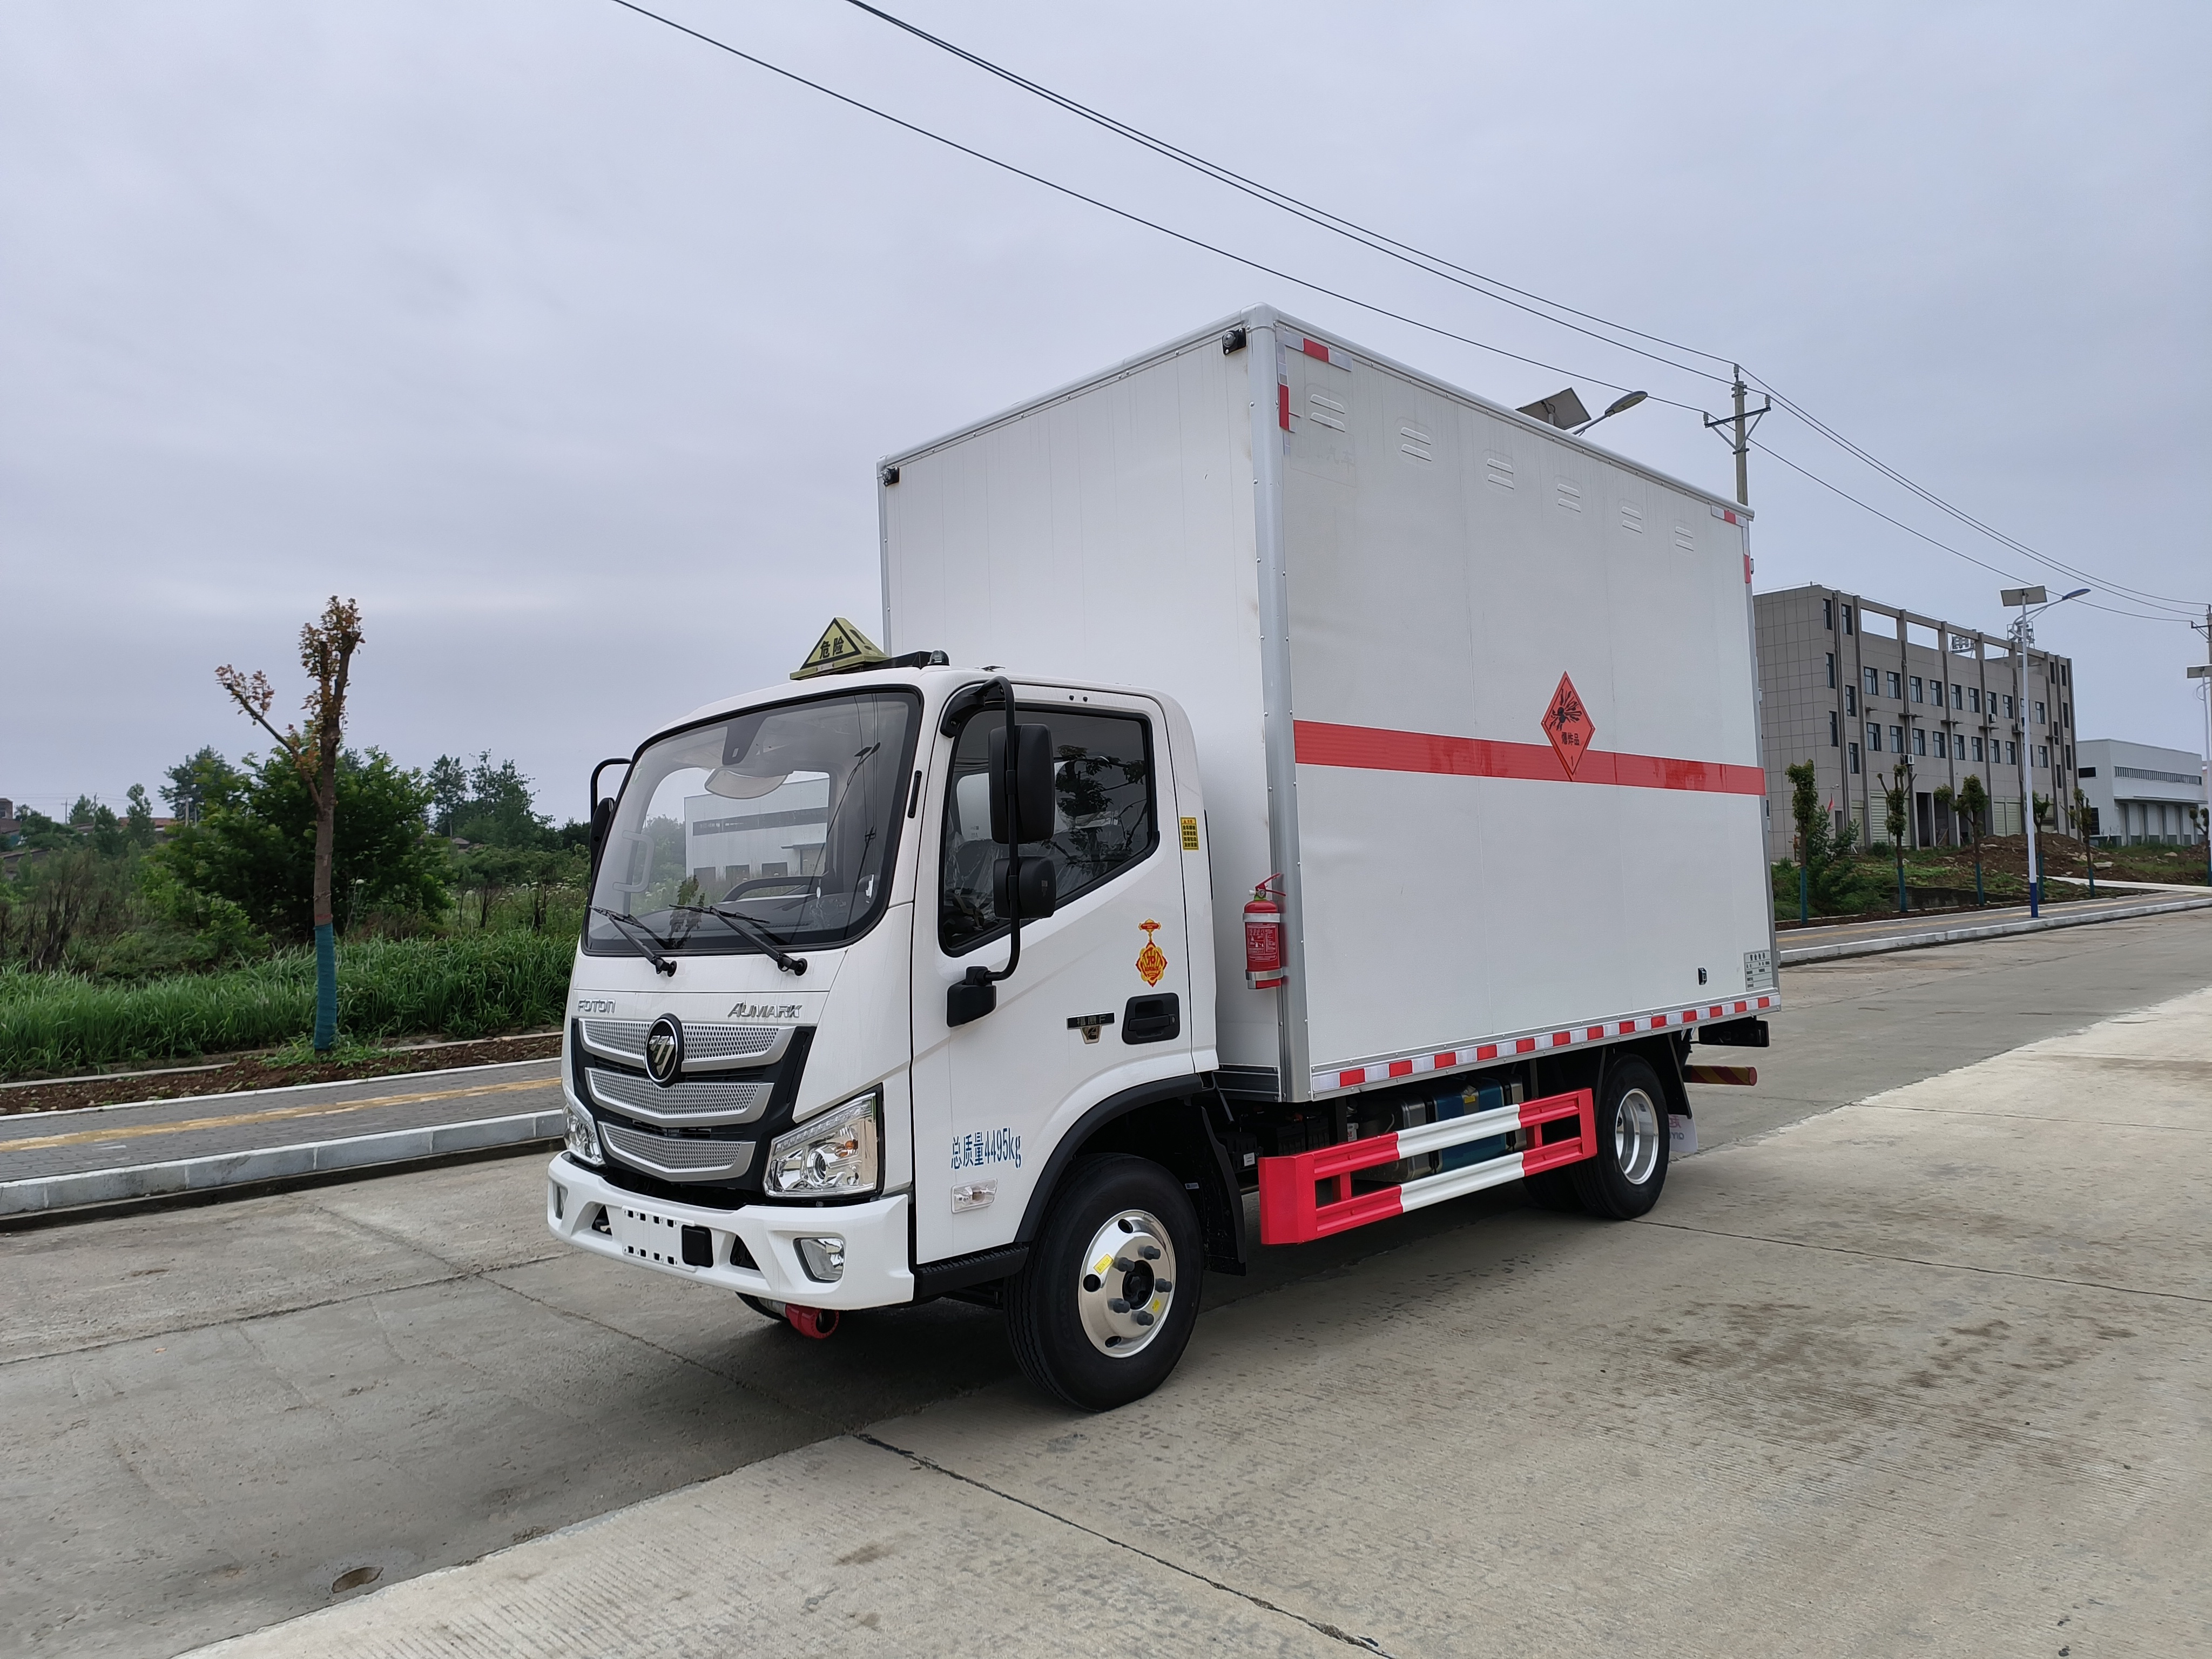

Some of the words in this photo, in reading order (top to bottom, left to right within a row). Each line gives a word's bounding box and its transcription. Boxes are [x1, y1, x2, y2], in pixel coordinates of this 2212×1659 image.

[819, 636, 845, 659] 危险
[1561, 732, 1580, 745] 爆炸品
[1570, 755, 1574, 767] 1
[577, 999, 616, 1013] FOTON
[727, 1000, 803, 1019] AUMARK
[950, 1127, 1022, 1169] 总质量4495kg
